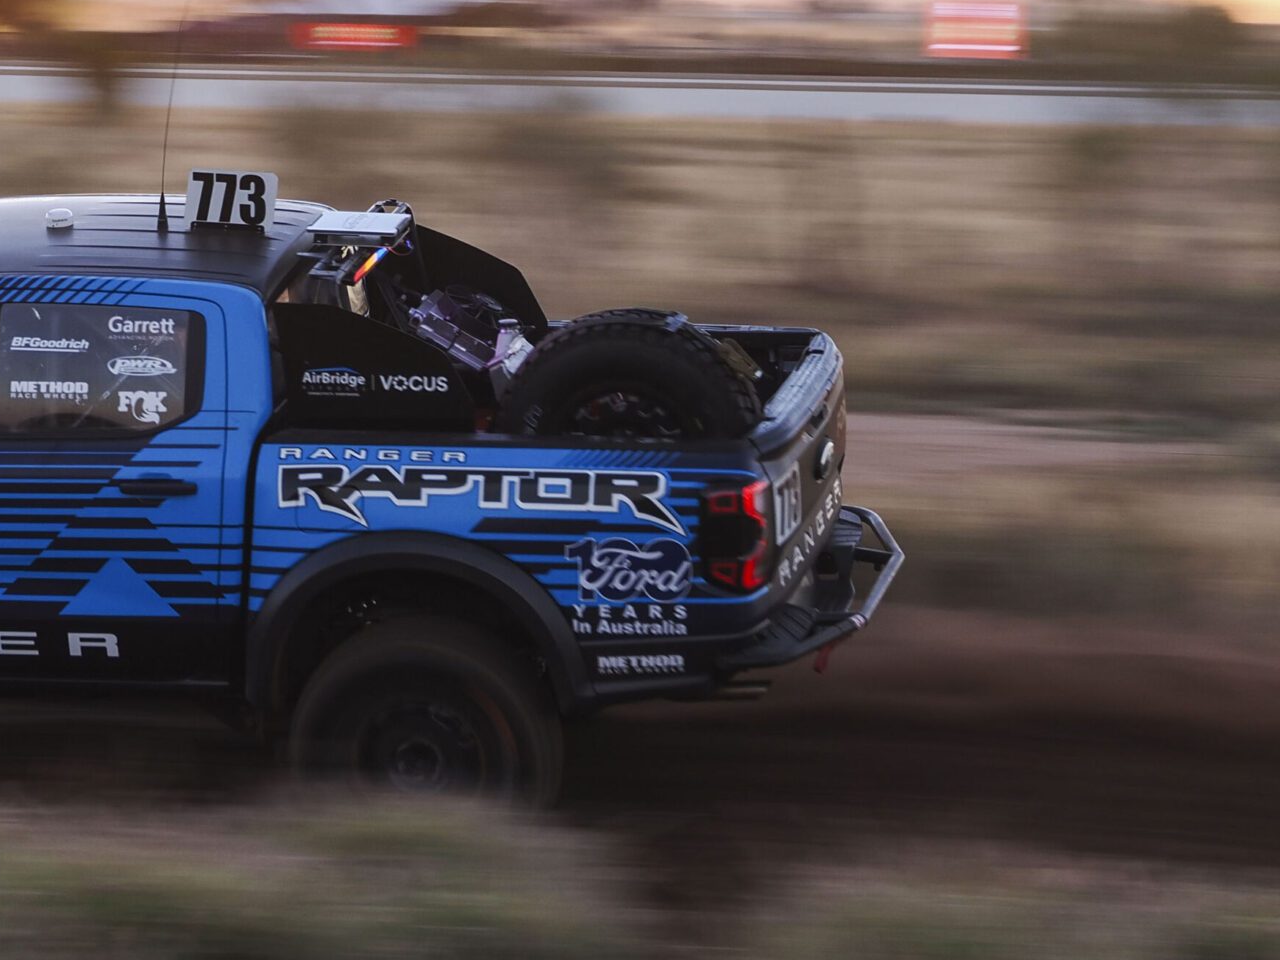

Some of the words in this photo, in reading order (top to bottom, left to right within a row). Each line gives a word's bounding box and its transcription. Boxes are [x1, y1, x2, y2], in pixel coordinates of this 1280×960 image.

[192, 172, 267, 227] 773
[108, 315, 175, 334] Garrett
[10, 336, 90, 350] BFGoodrich
[10, 381, 89, 394] METHOD
[302, 371, 366, 387] AirBridge
[379, 375, 449, 392] VOCUS
[278, 447, 469, 463] RANGER
[277, 464, 689, 537] RAPTOR
[580, 548, 692, 593] Ford
[572, 604, 688, 619] YEARS
[572, 619, 592, 633] In
[596, 620, 688, 635] Australia
